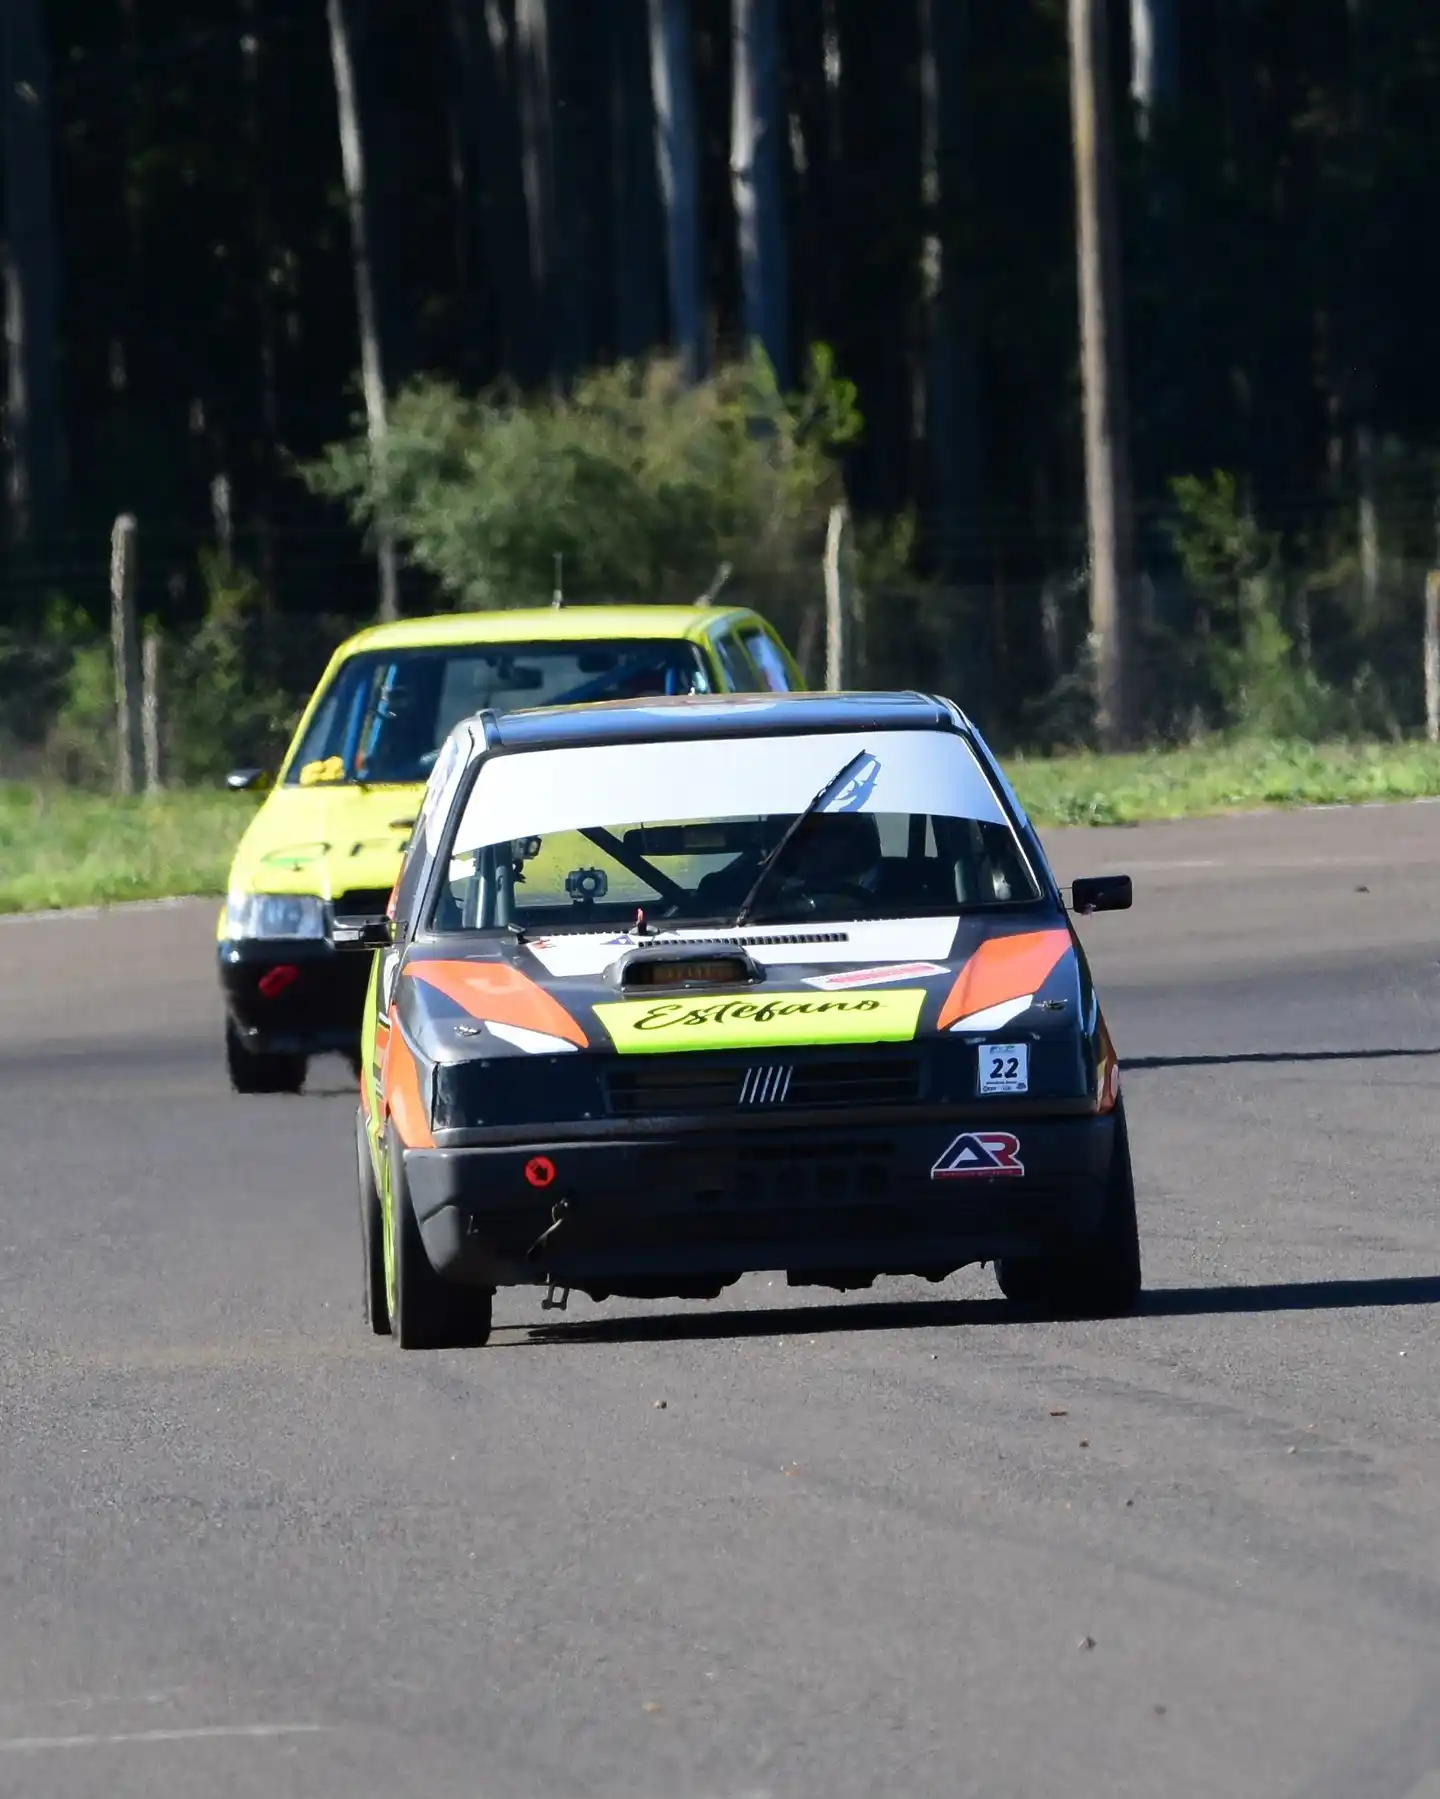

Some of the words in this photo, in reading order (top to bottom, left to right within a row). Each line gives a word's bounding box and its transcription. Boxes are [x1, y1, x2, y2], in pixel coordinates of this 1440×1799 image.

[633, 998, 882, 1031] Estefano
[990, 1057, 1019, 1079] 22
[932, 1132, 1024, 1170] AR
